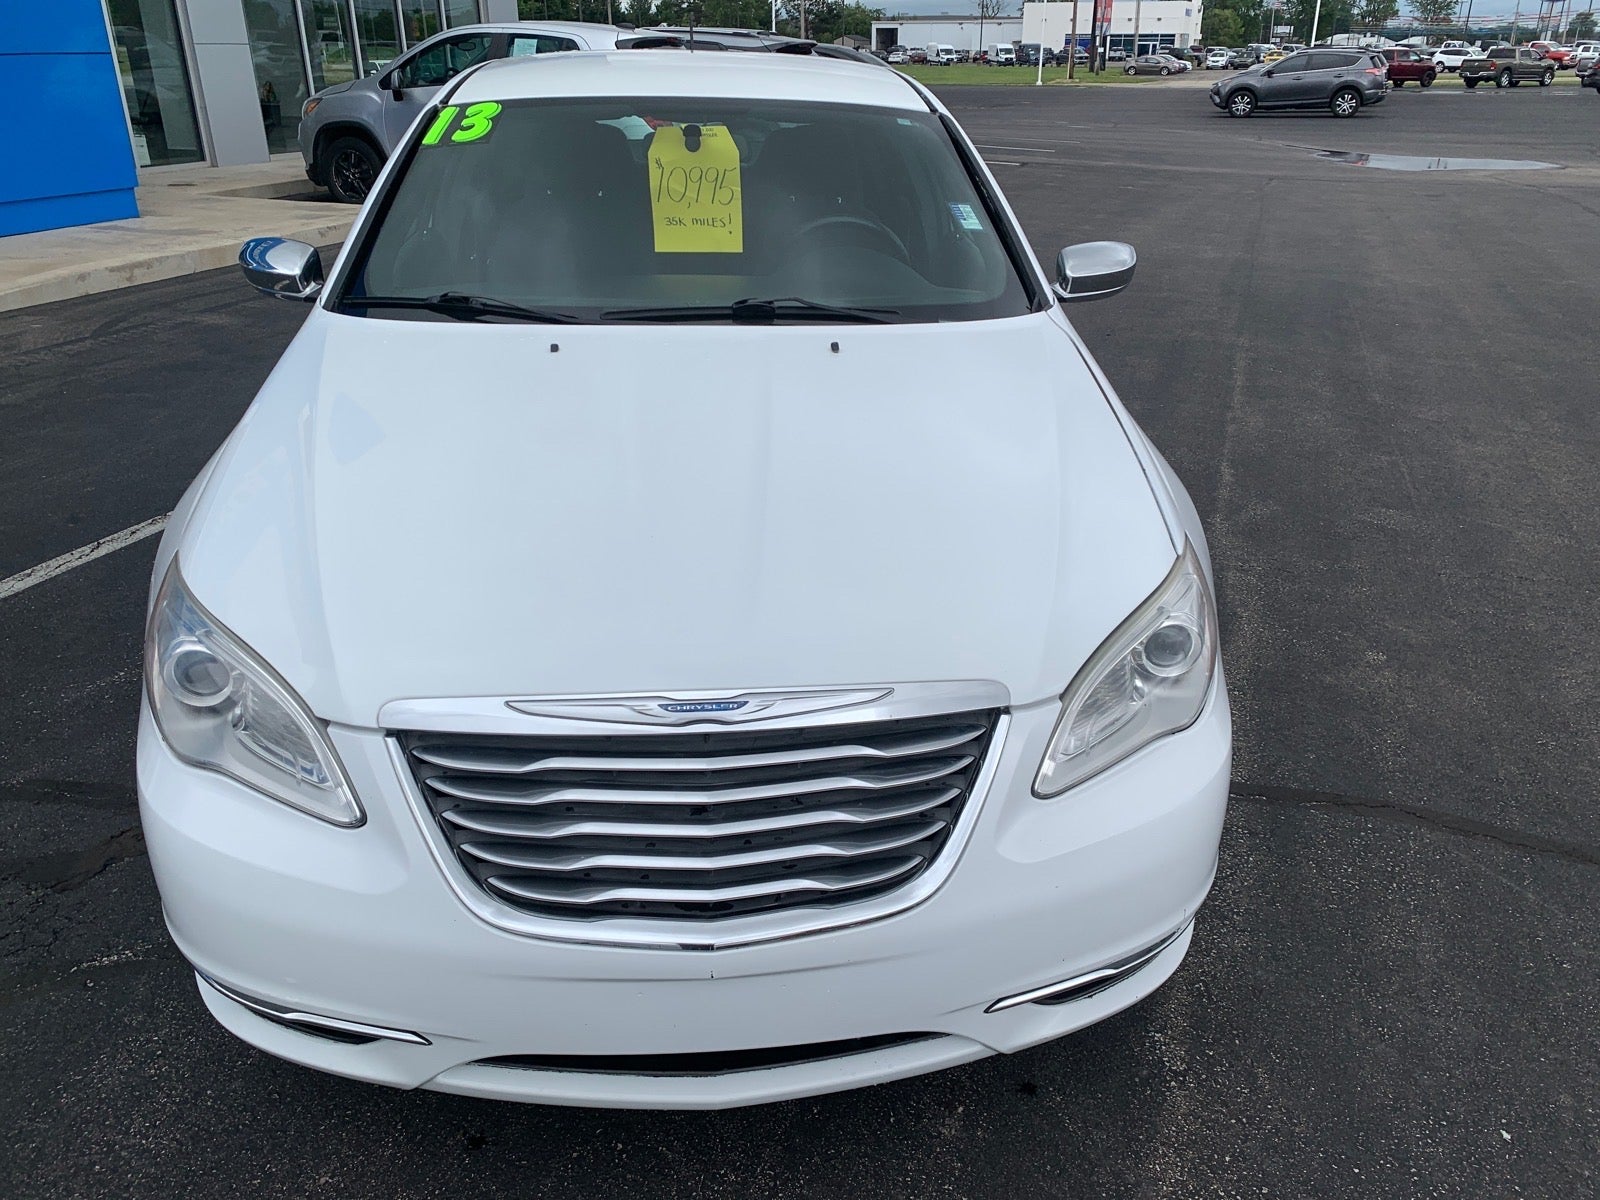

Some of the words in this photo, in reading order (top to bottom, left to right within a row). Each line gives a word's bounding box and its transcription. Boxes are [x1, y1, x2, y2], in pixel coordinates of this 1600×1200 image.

[421, 102, 502, 145] 13
[655, 157, 737, 208] $10,995
[663, 216, 687, 227] 35K
[667, 703, 739, 712] CHRYSLER
